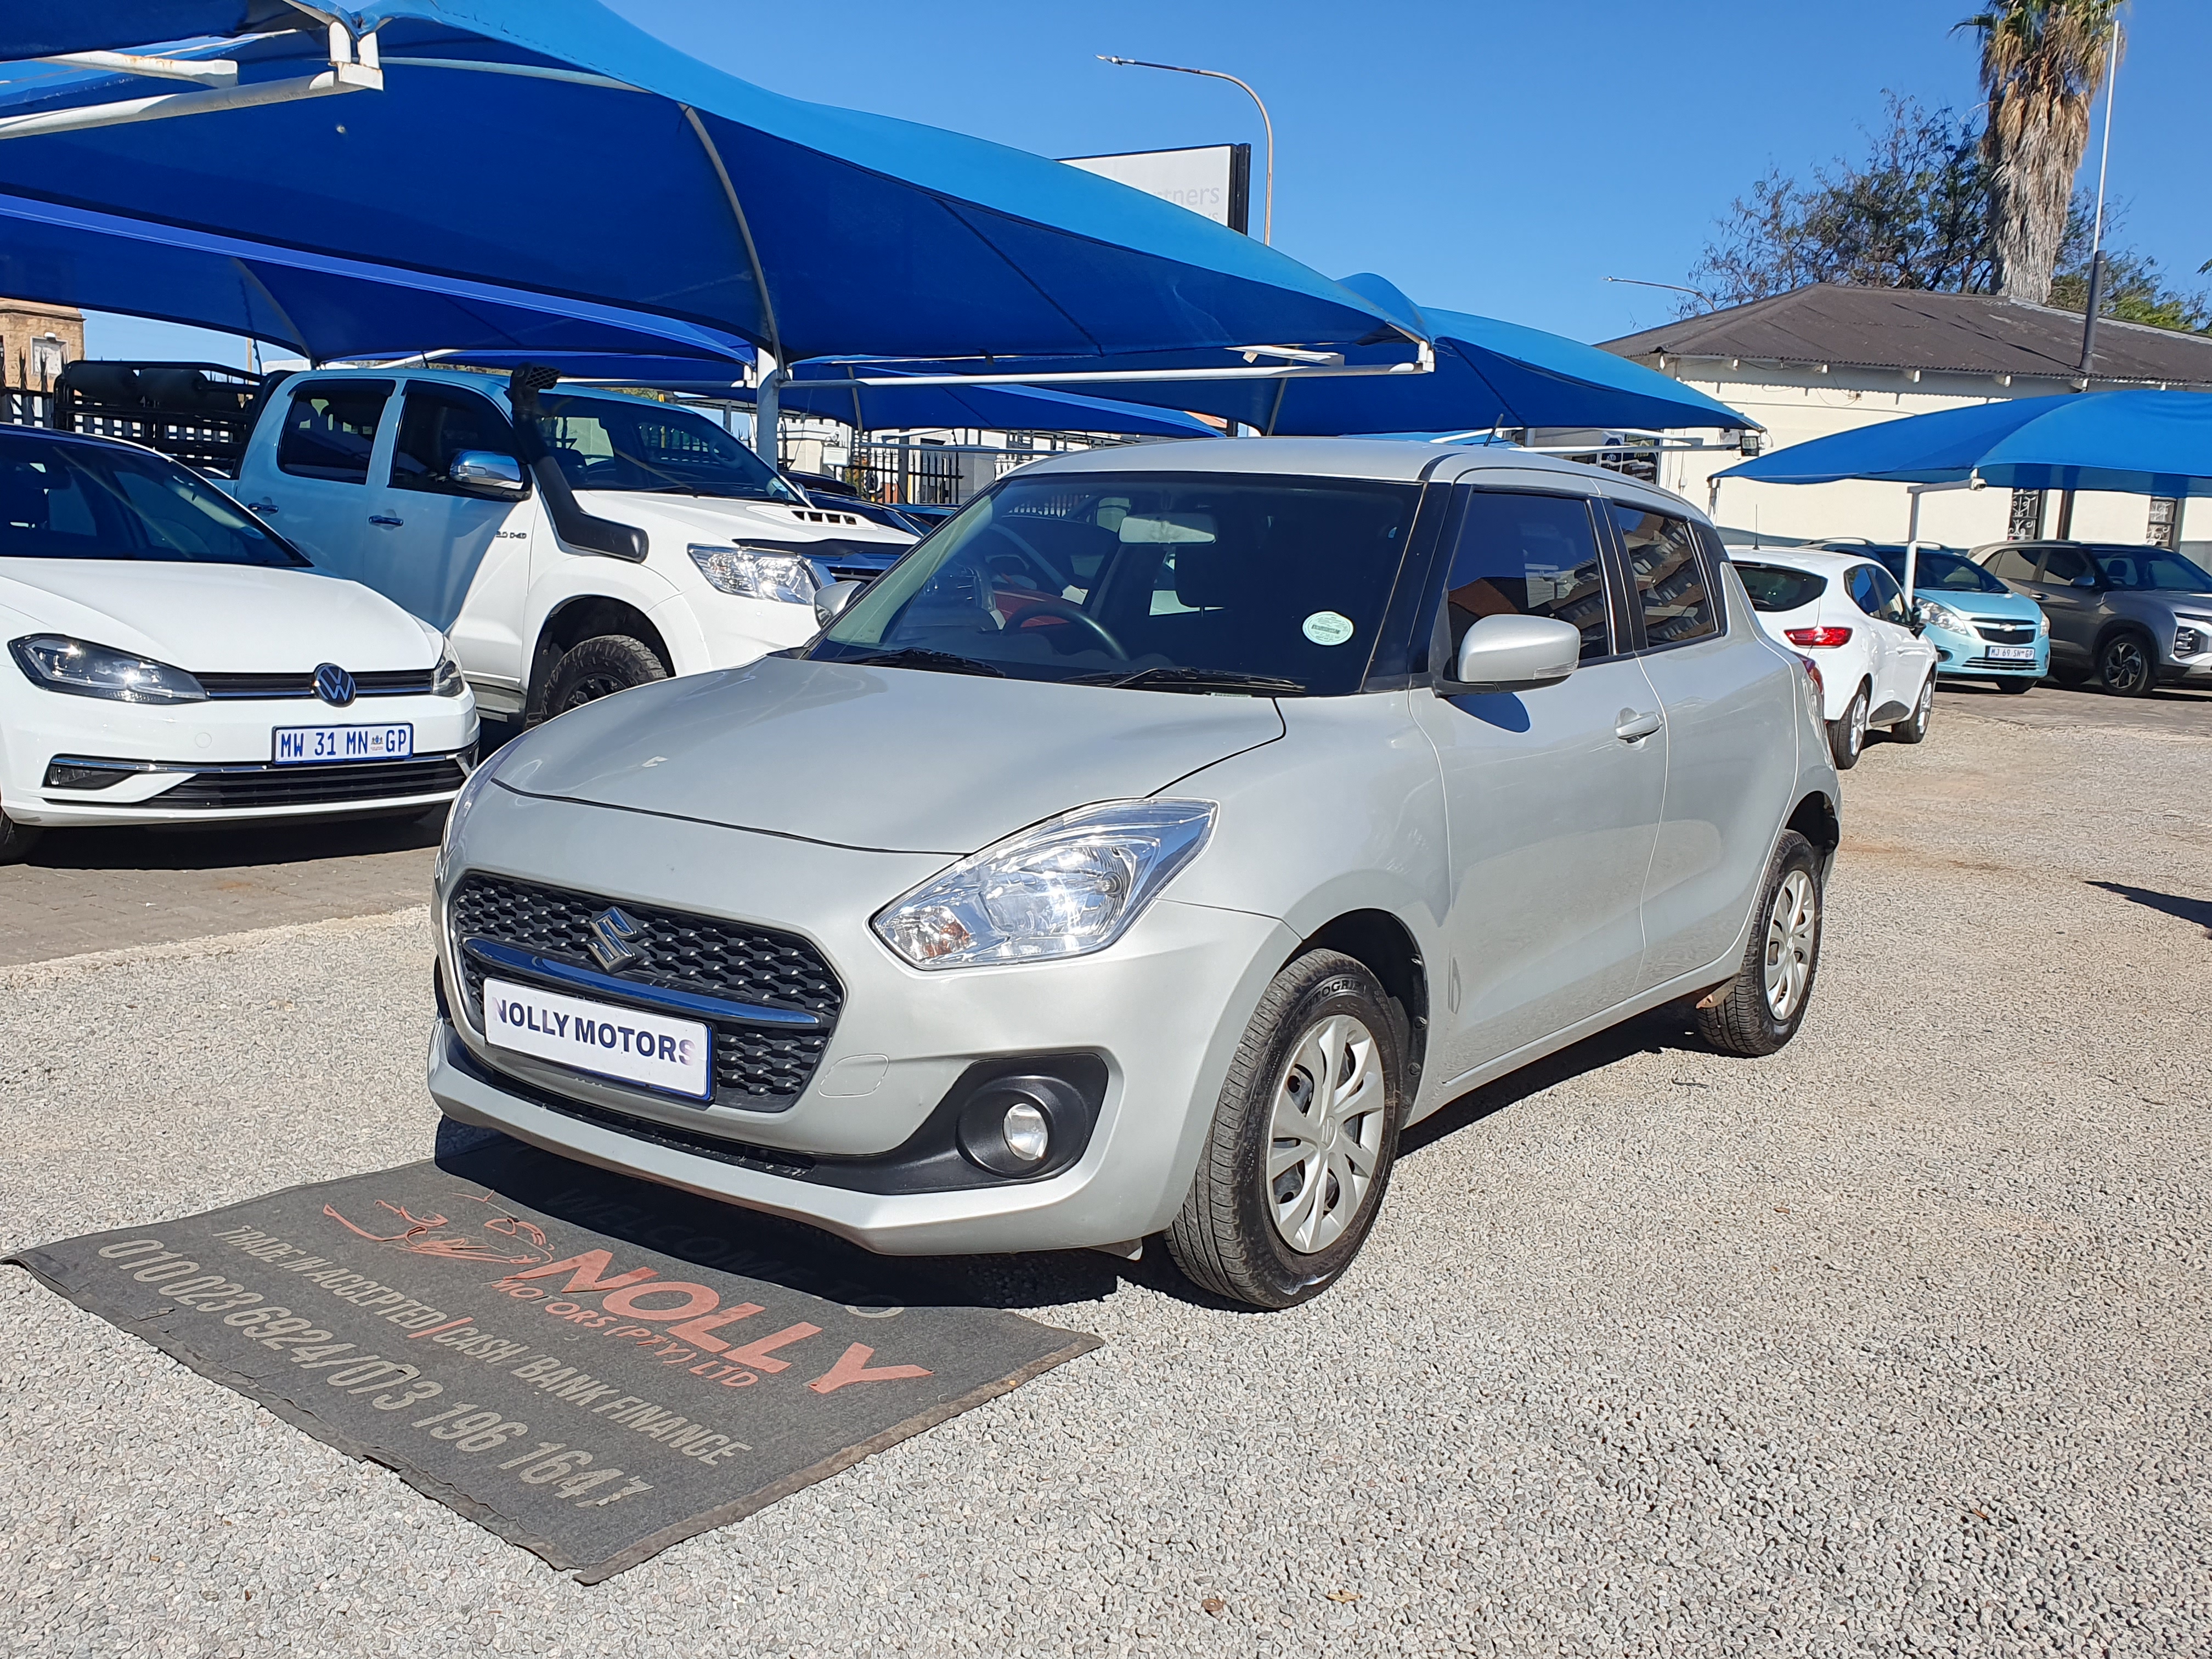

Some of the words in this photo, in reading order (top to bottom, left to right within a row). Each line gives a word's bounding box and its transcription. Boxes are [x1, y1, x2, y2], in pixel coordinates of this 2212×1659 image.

[280, 733, 304, 758] MW
[314, 732, 336, 755] 31
[346, 731, 368, 754] MN
[386, 729, 407, 752] GP
[492, 996, 569, 1037] NOLLY
[575, 1017, 696, 1066] MOTORS
[98, 1239, 200, 1283] 010
[158, 1276, 264, 1312] 023
[411, 1401, 528, 1452] 196
[498, 1441, 655, 1508] 1647
[212, 1225, 307, 1262] TRADE
[277, 1256, 334, 1272] IN
[510, 1356, 620, 1406] BANK
[591, 1395, 753, 1465] FINANCE
[503, 1249, 934, 1393] NOLLY
[603, 1325, 697, 1364] (PTY)
[689, 1361, 759, 1387] LTD
